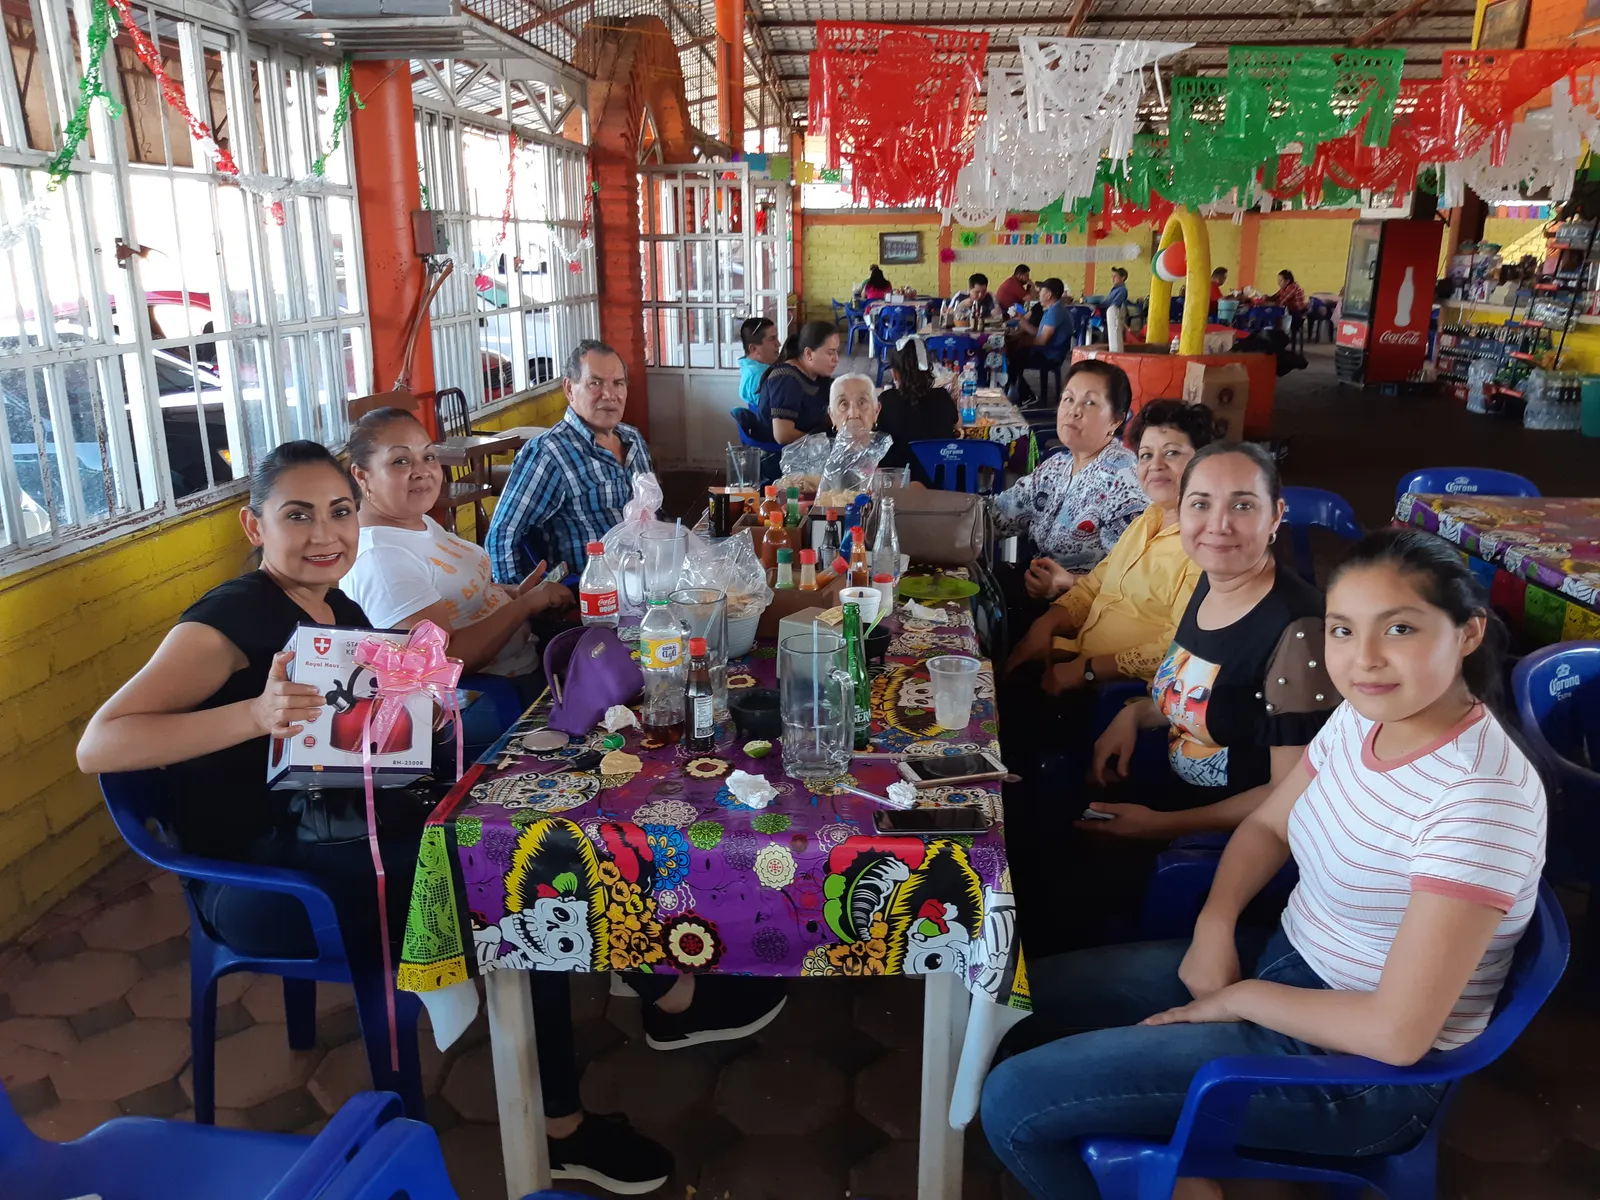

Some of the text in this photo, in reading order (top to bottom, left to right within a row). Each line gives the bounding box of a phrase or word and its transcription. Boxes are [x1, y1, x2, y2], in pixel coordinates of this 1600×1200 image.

[1445, 482, 1478, 492] Corona
[305, 660, 322, 668] Royal
[1549, 673, 1580, 697] Corona
